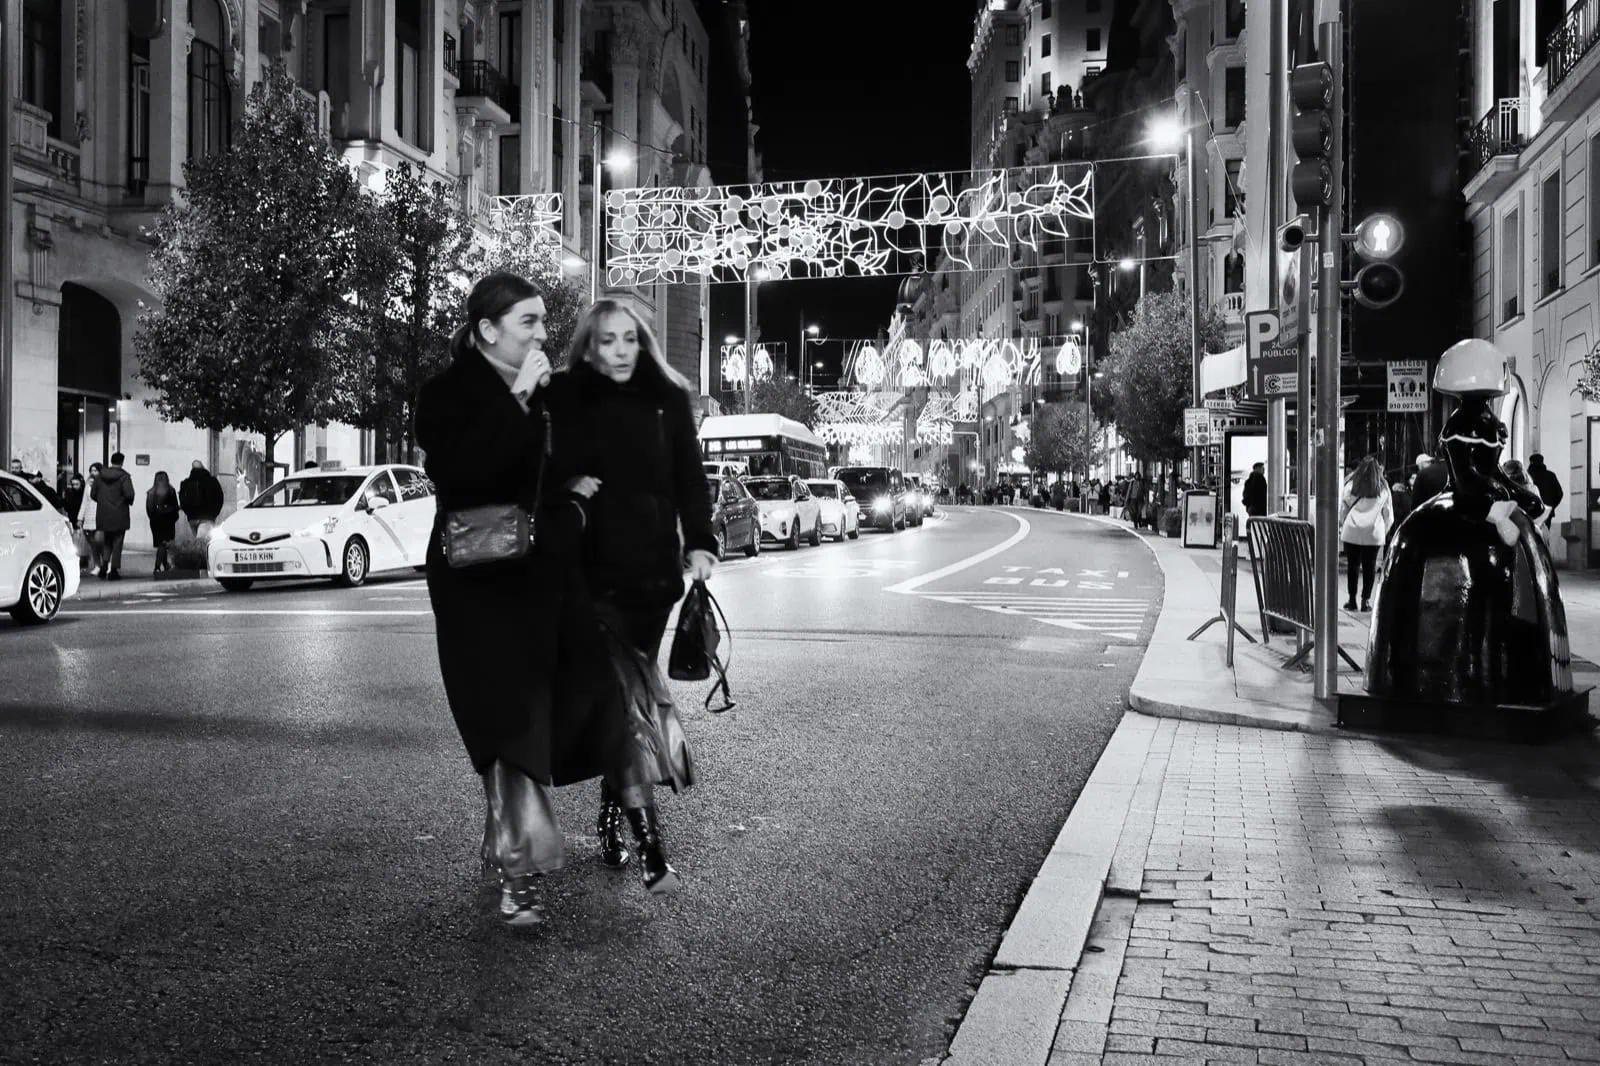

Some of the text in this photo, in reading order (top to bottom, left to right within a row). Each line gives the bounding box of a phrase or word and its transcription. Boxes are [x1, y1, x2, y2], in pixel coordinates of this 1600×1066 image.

[1249, 313, 1280, 359] P
[1002, 566, 1129, 578] TAXI
[983, 577, 1115, 590] BUS
